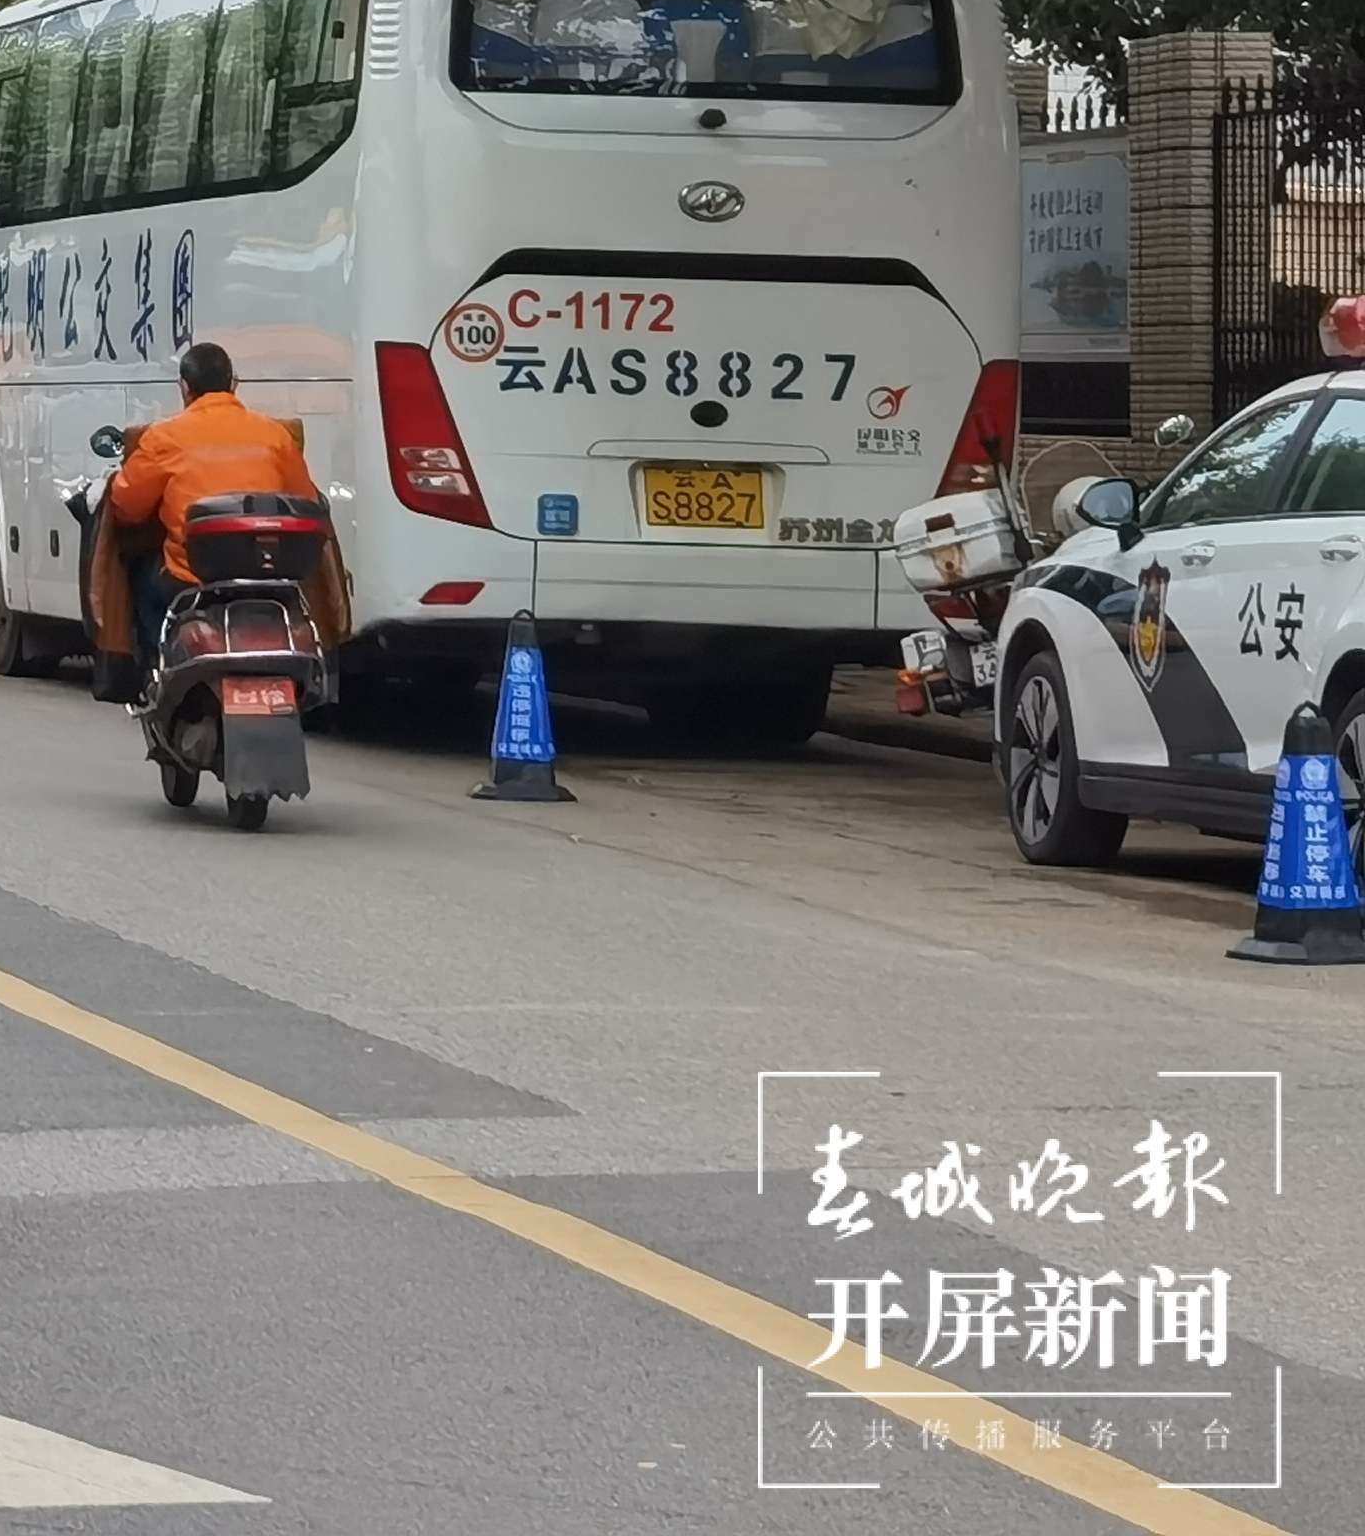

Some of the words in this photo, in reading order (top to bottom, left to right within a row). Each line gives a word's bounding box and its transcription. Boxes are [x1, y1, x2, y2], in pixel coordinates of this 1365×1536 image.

[508, 289, 675, 332] C-1172
[453, 325, 496, 345] 100
[495, 346, 856, 401] 云AS8827
[652, 491, 757, 523] S8827
[1238, 582, 1305, 662] 公安
